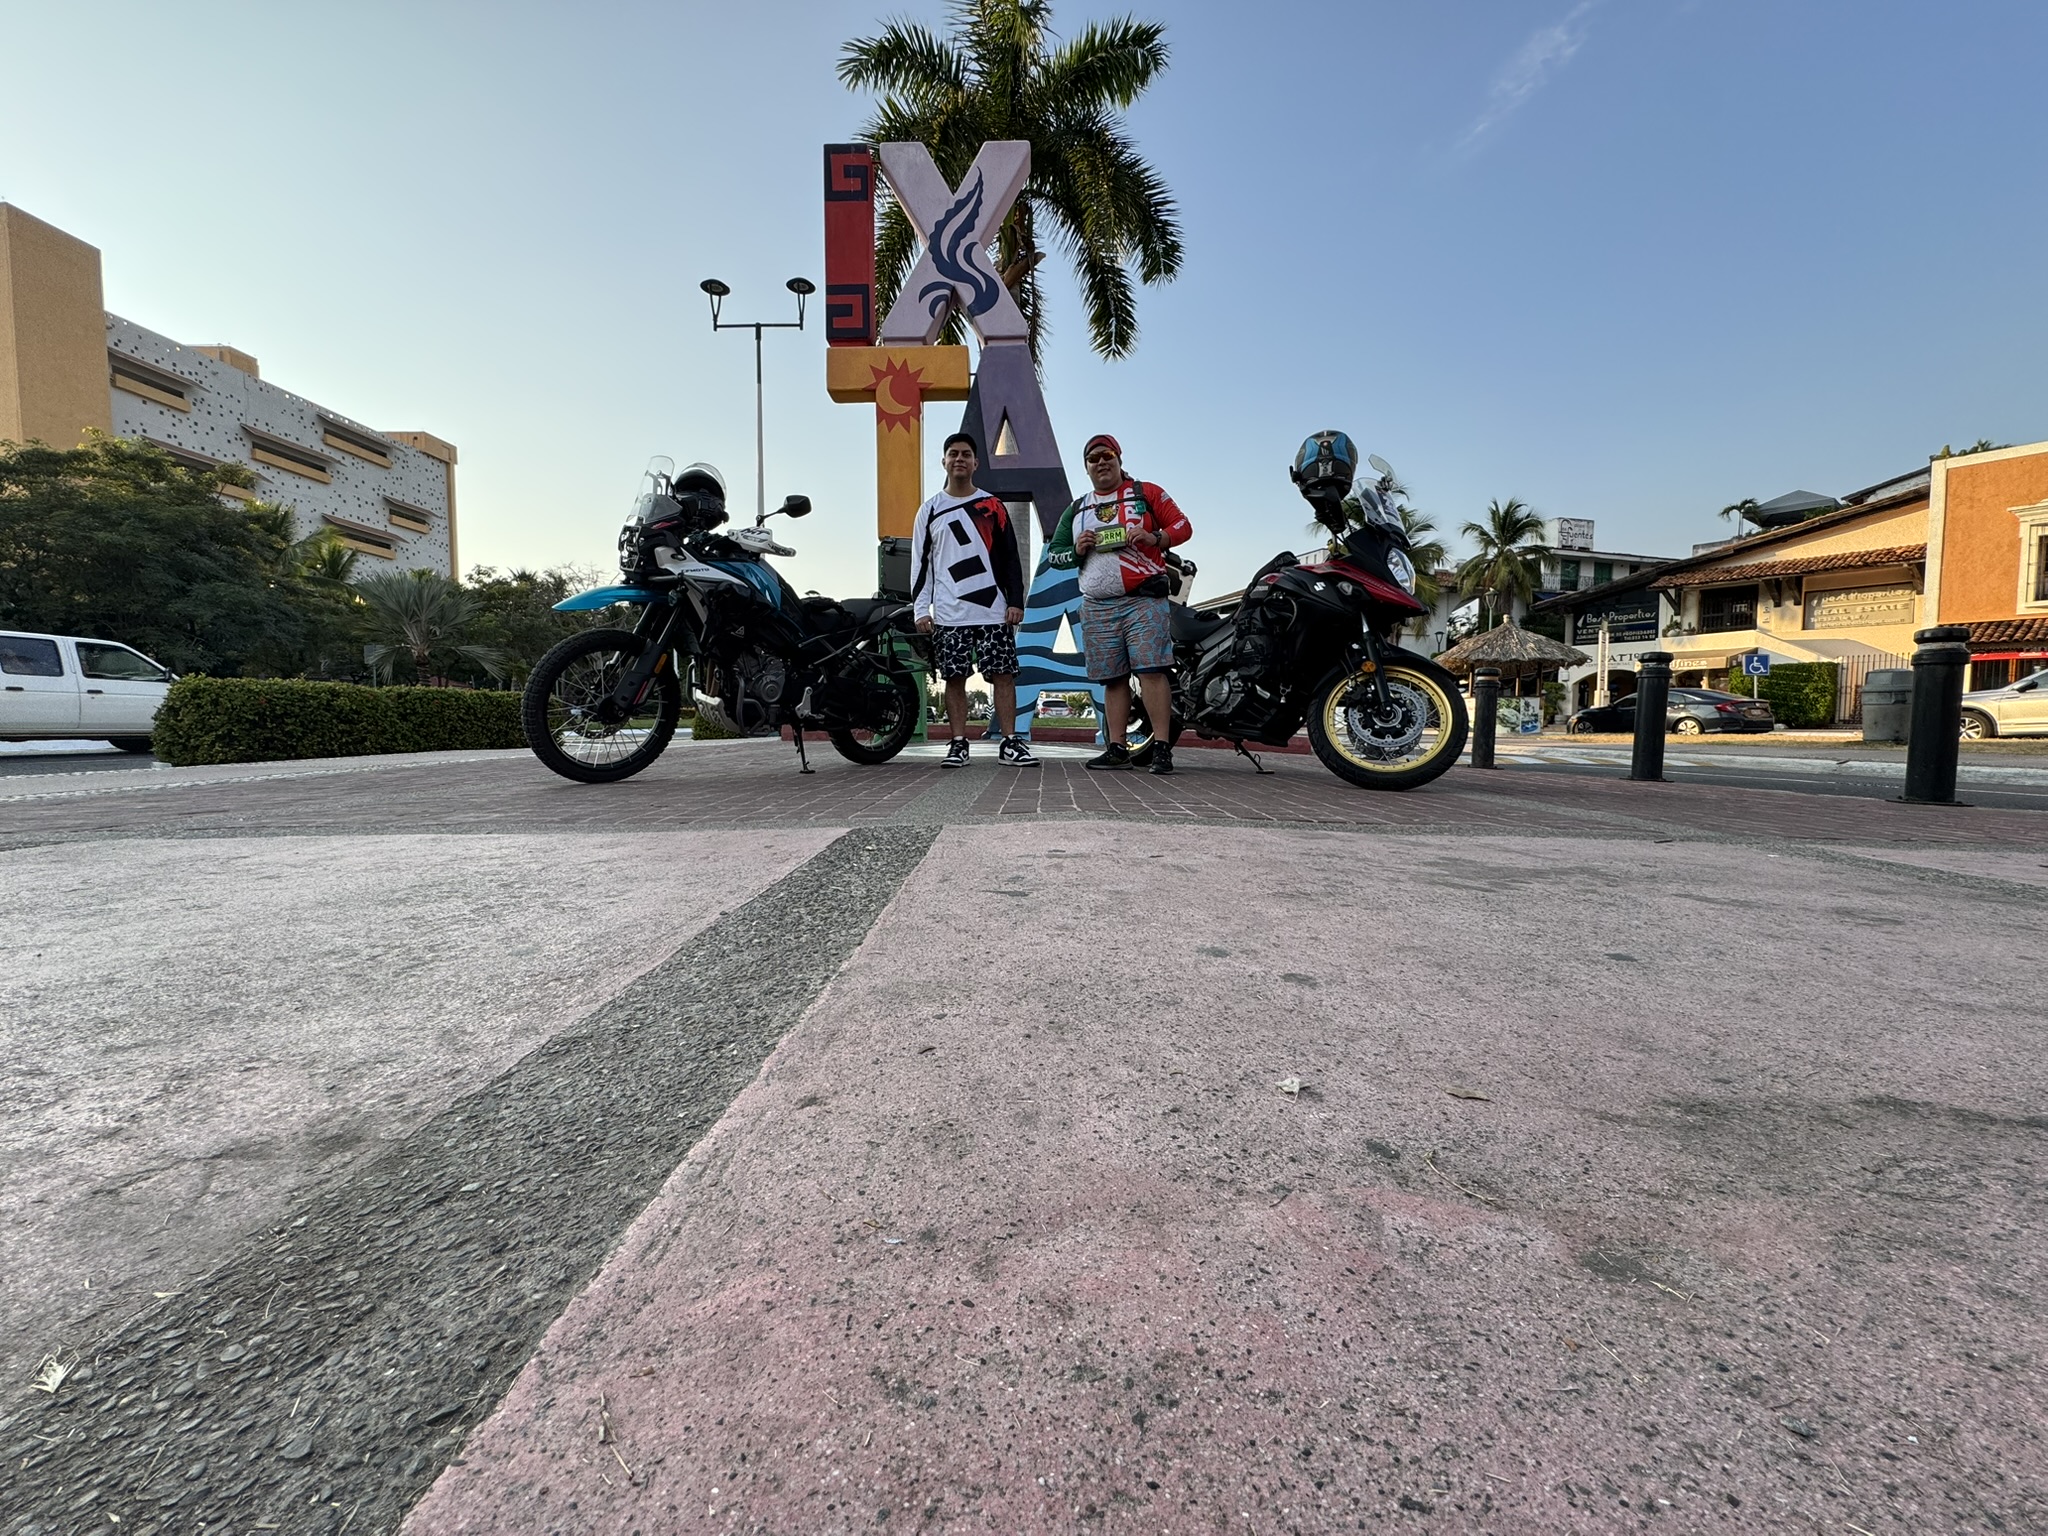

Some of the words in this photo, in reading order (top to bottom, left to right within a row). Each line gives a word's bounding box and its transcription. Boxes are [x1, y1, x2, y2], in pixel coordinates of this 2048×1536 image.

[1104, 531, 1121, 541] RRM
[1814, 607, 1848, 616] REAL
[1856, 602, 1907, 613] ESTATE
[1586, 612, 1606, 624] Best
[1609, 609, 1656, 623] Properties
